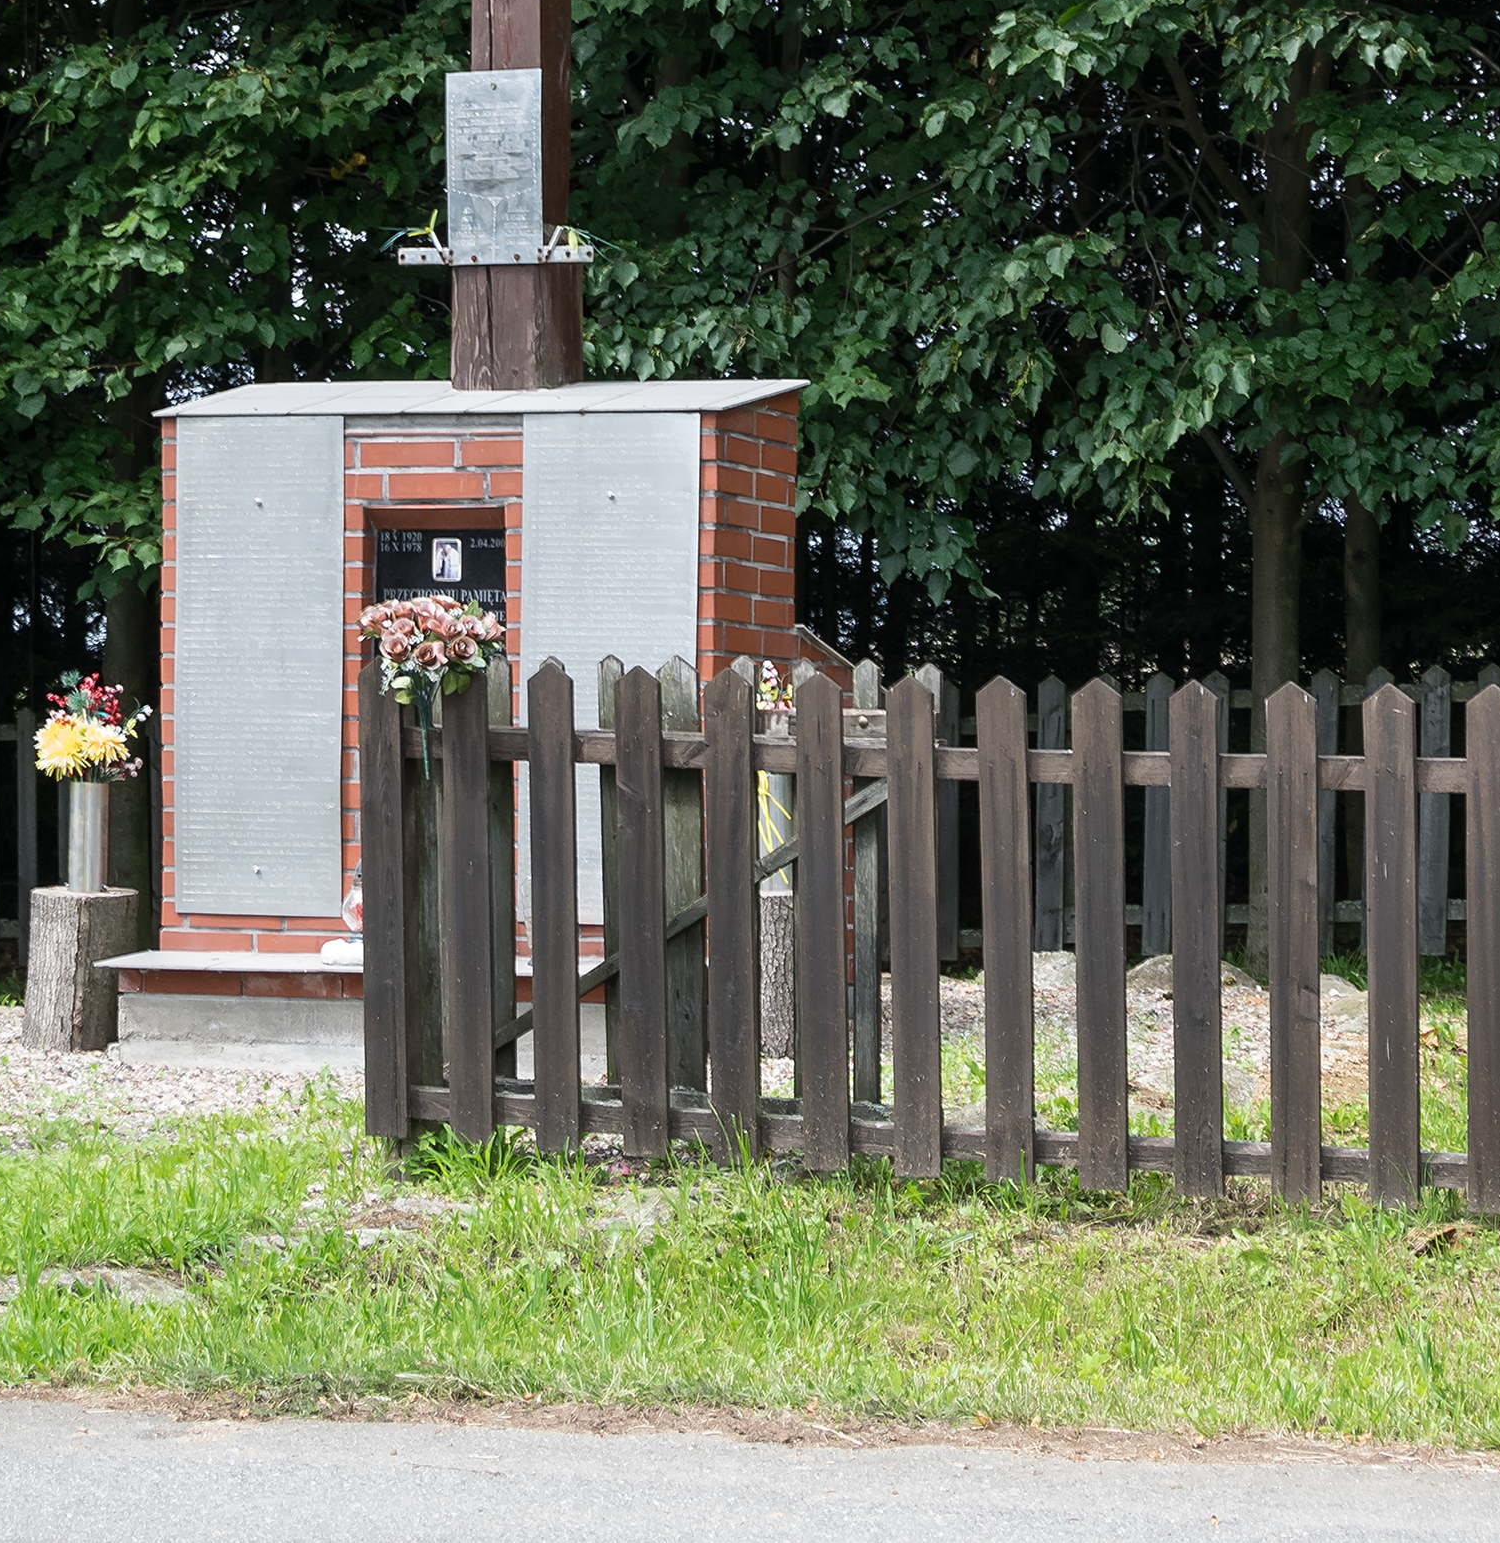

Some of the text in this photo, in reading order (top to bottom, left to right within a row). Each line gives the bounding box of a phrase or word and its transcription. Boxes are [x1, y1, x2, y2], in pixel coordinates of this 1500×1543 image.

[380, 531, 391, 542] 18
[402, 531, 423, 542] 1920
[380, 542, 423, 553] 16 X 1978
[470, 538, 506, 548] 2.04.200
